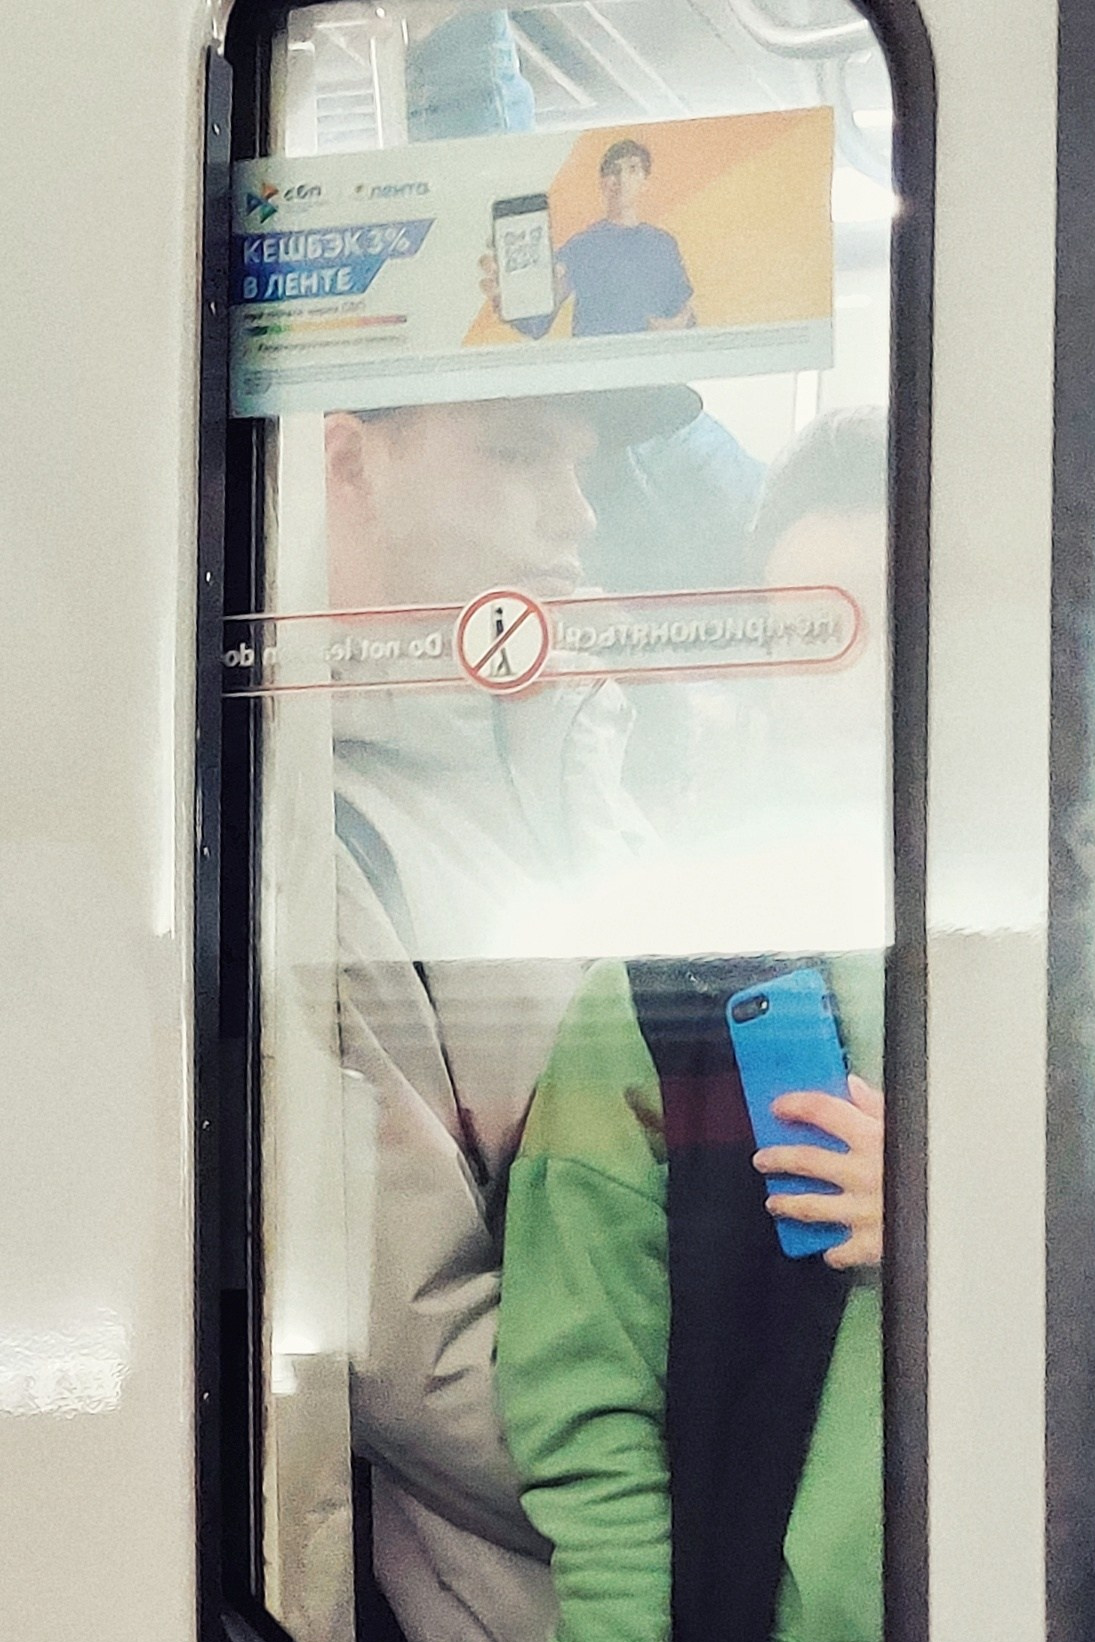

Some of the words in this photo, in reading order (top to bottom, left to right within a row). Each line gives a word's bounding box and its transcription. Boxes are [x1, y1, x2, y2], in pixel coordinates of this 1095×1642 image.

[243, 230, 363, 264] КЕШБЭК
[366, 227, 411, 254] 3%
[243, 276, 258, 299] В
[263, 266, 353, 299] ЛЕНТЕ
